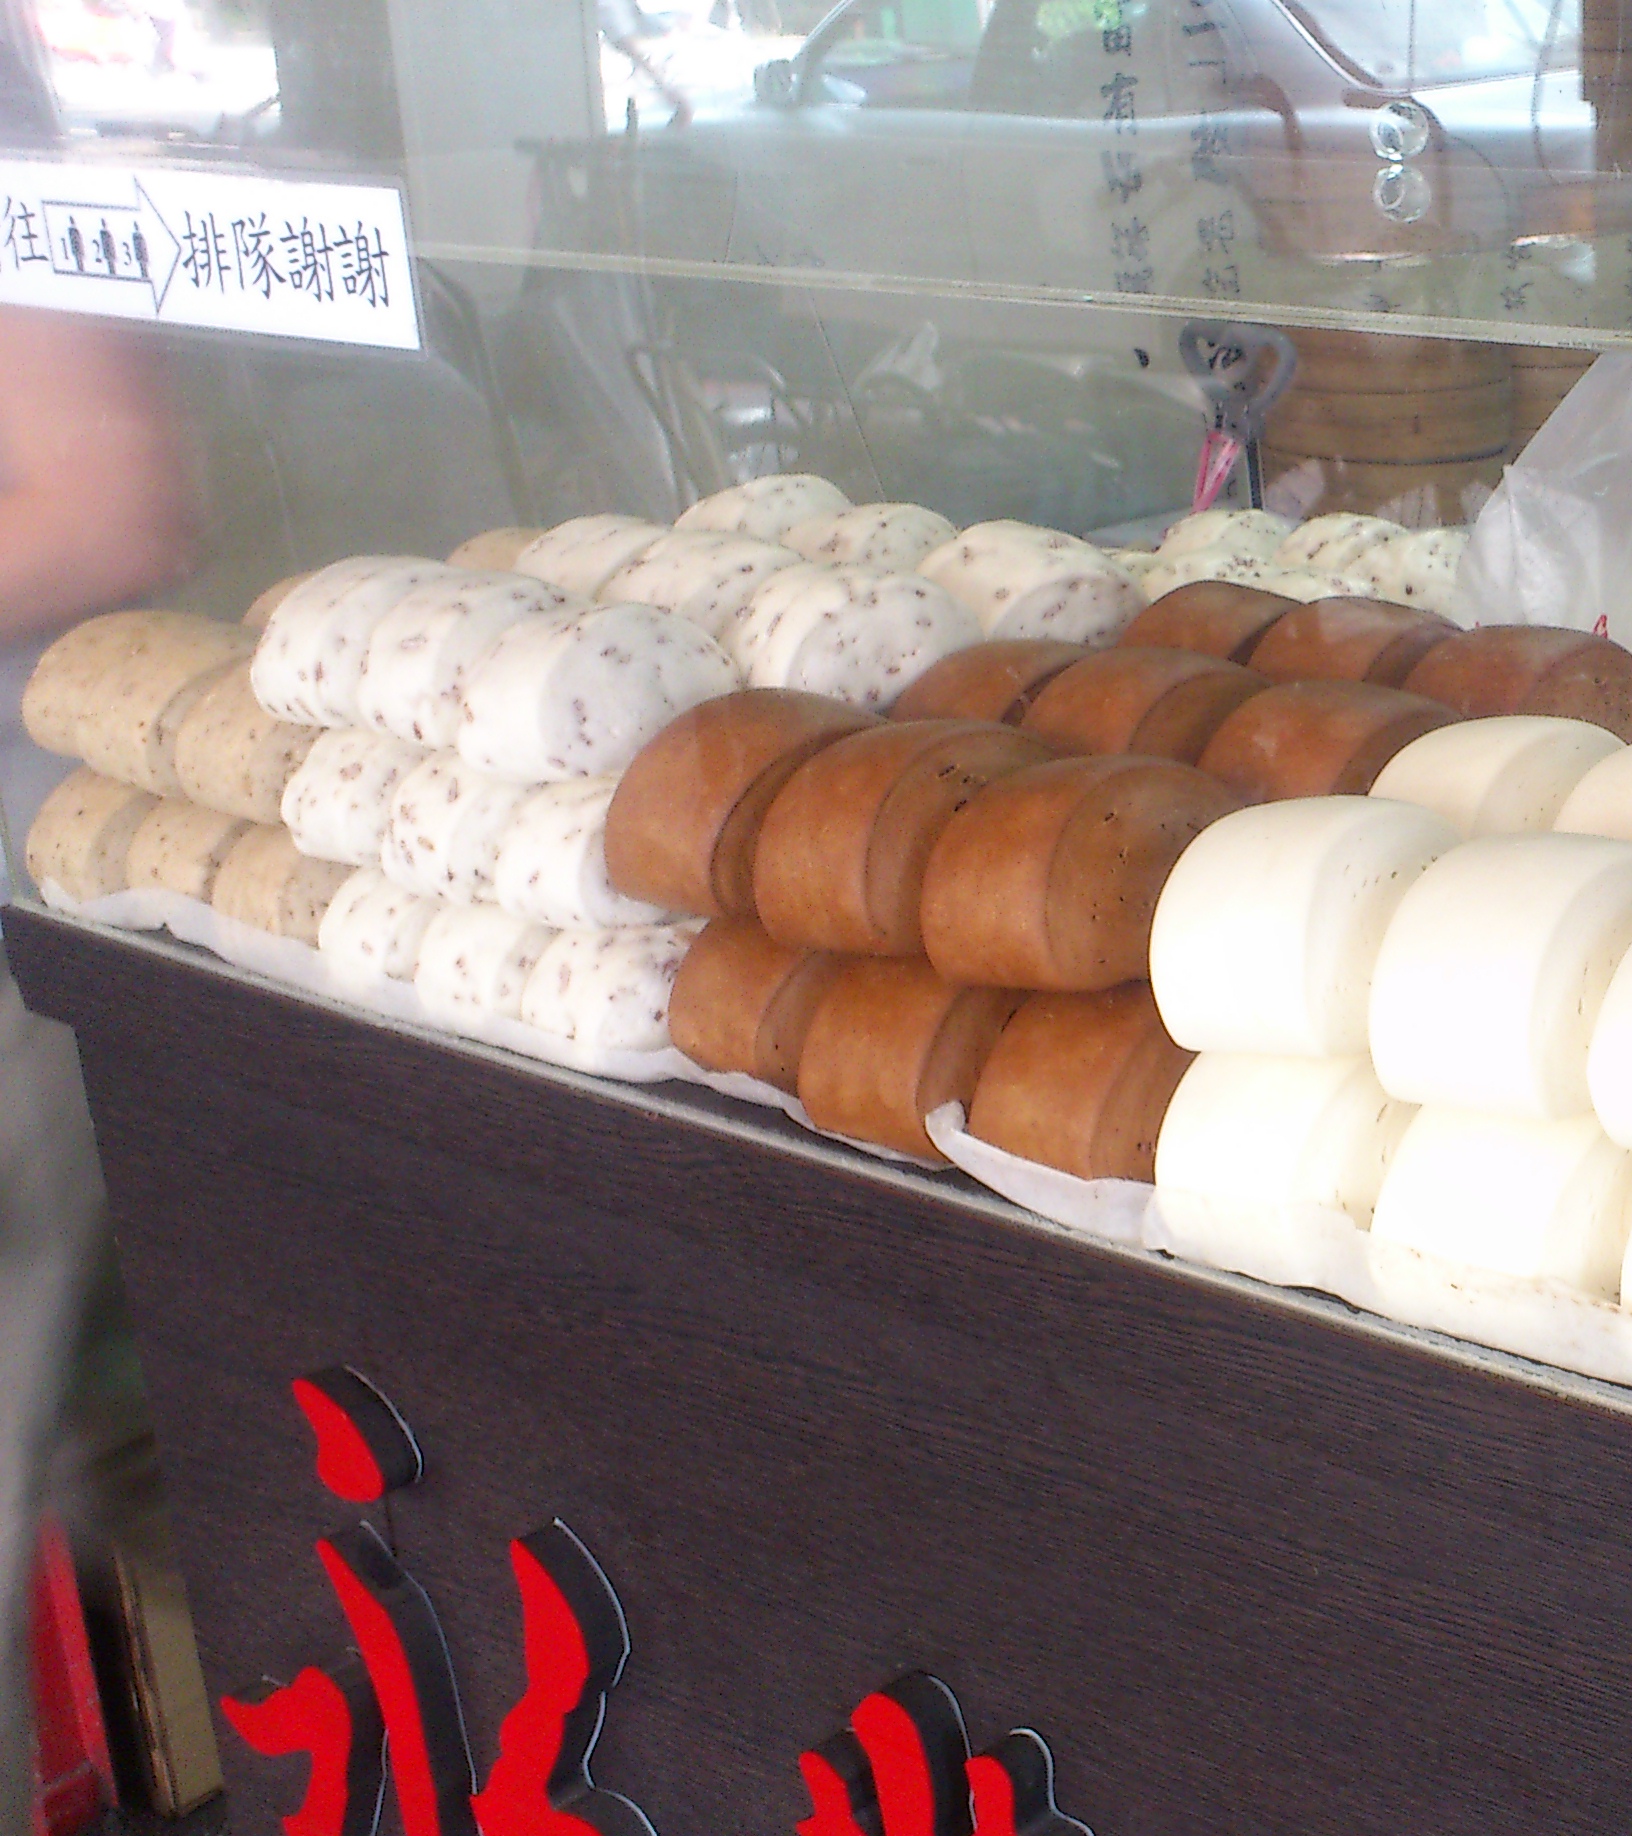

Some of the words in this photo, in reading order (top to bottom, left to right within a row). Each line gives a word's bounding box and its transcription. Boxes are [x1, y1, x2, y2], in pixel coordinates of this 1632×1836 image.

[60, 237, 70, 261] 1
[122, 241, 133, 266] 3
[182, 210, 390, 308] 排隊謝謝
